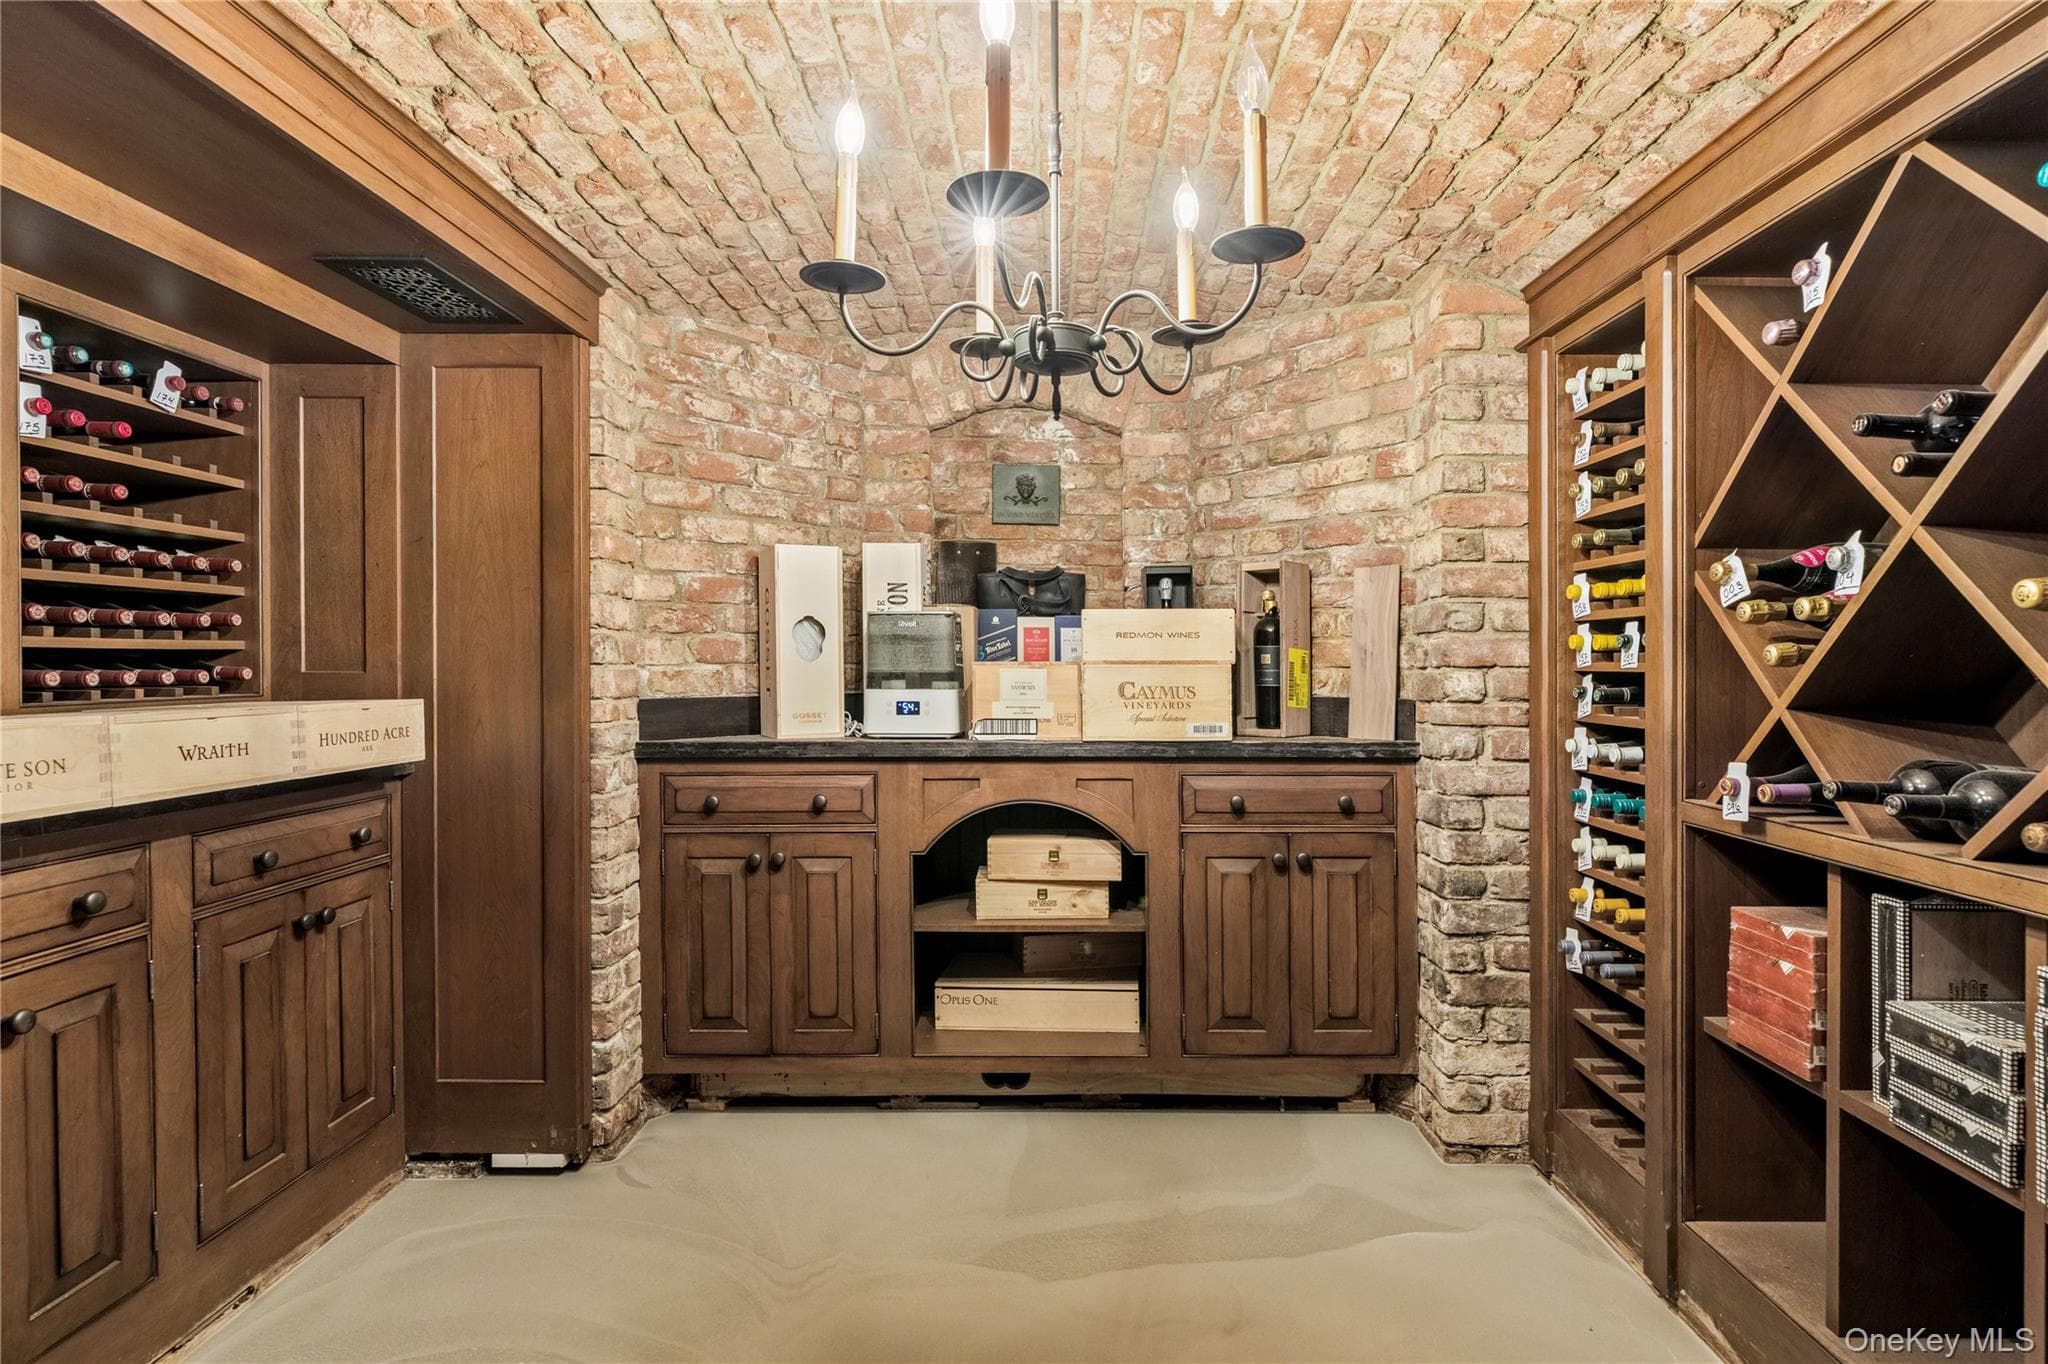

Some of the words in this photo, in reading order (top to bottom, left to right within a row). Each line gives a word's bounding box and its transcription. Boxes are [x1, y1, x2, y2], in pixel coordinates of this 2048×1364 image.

[887, 582, 909, 610] ON
[1723, 581, 1744, 598] 003
[1116, 631, 1163, 639] REDMON
[1167, 631, 1201, 639] WINES
[1118, 681, 1197, 701] CAYMUS
[902, 702, 915, 714] 54
[1123, 701, 1193, 710] VINEYARDS
[319, 729, 379, 747] HUNDRED
[383, 726, 411, 740] ACRE
[177, 742, 249, 762] WRAITH
[23, 758, 66, 777] SON
